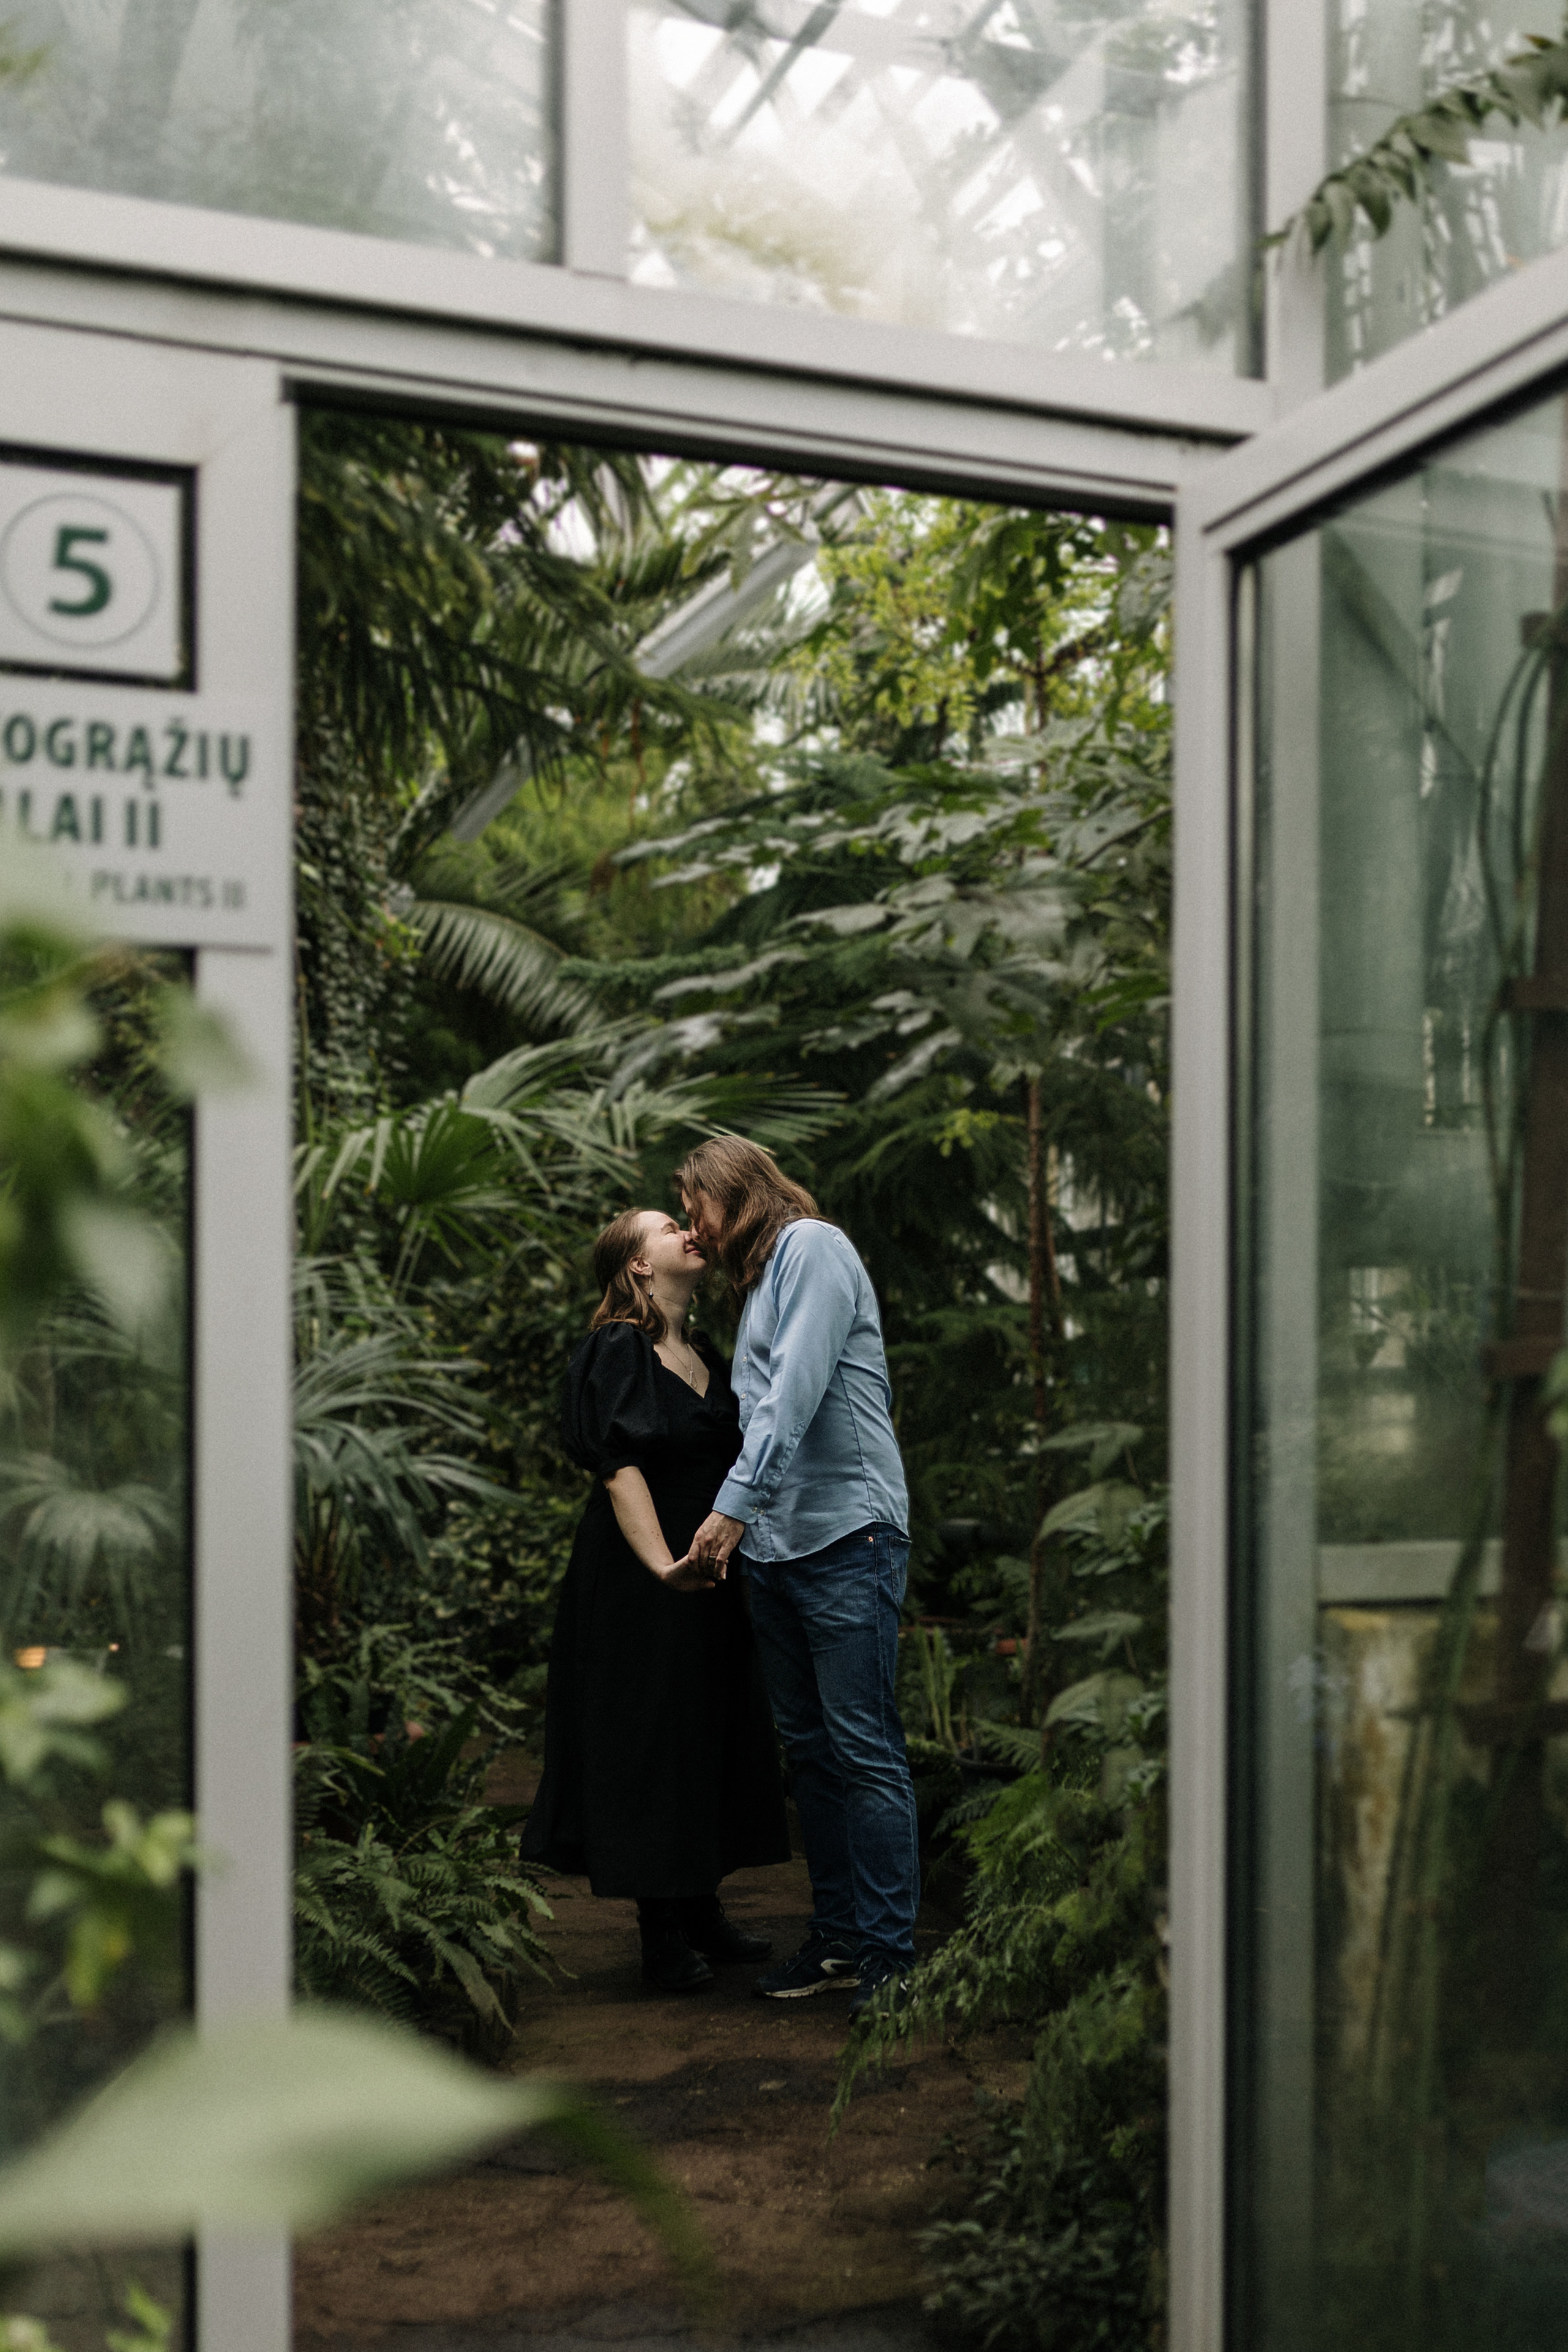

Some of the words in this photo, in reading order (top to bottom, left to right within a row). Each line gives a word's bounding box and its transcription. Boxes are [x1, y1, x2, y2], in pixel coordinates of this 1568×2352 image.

[49, 524, 113, 617] 5
[0, 786, 104, 846] LAI
[126, 797, 161, 850] II
[91, 868, 214, 910] PLANTS
